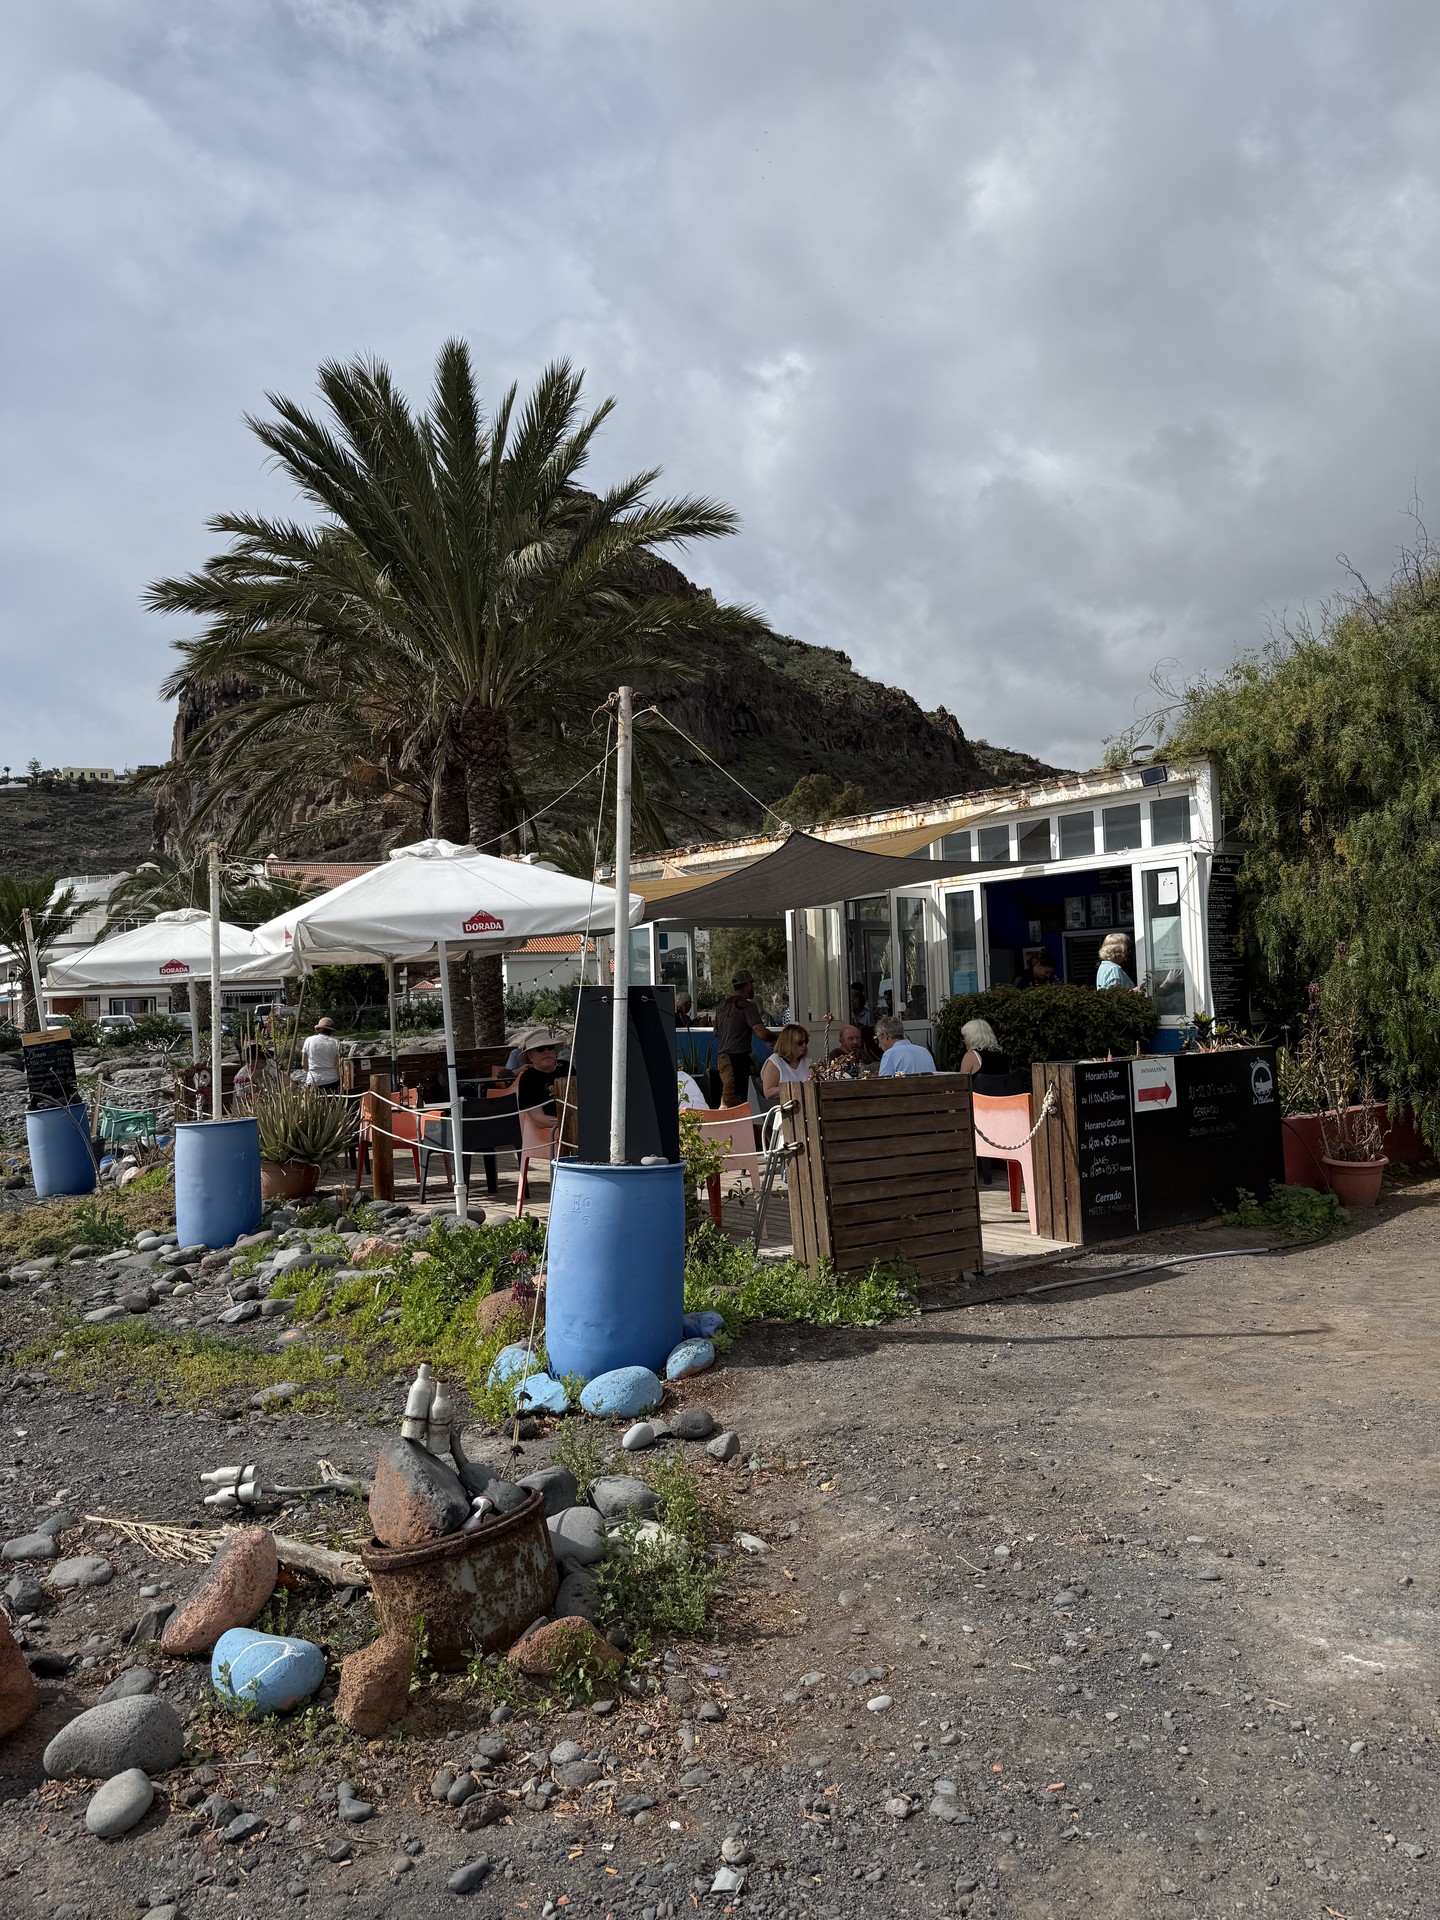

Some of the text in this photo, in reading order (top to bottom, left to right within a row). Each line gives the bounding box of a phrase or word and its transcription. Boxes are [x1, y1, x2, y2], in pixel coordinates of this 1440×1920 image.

[465, 922, 502, 932] DORADA
[161, 966, 188, 974] DORADA
[1085, 1069, 1120, 1081] Horario Bar
[1193, 1106, 1219, 1118] CERRADO
[1084, 1118, 1126, 1131] Horario Cocina
[1095, 1190, 1122, 1204] Cerrado
